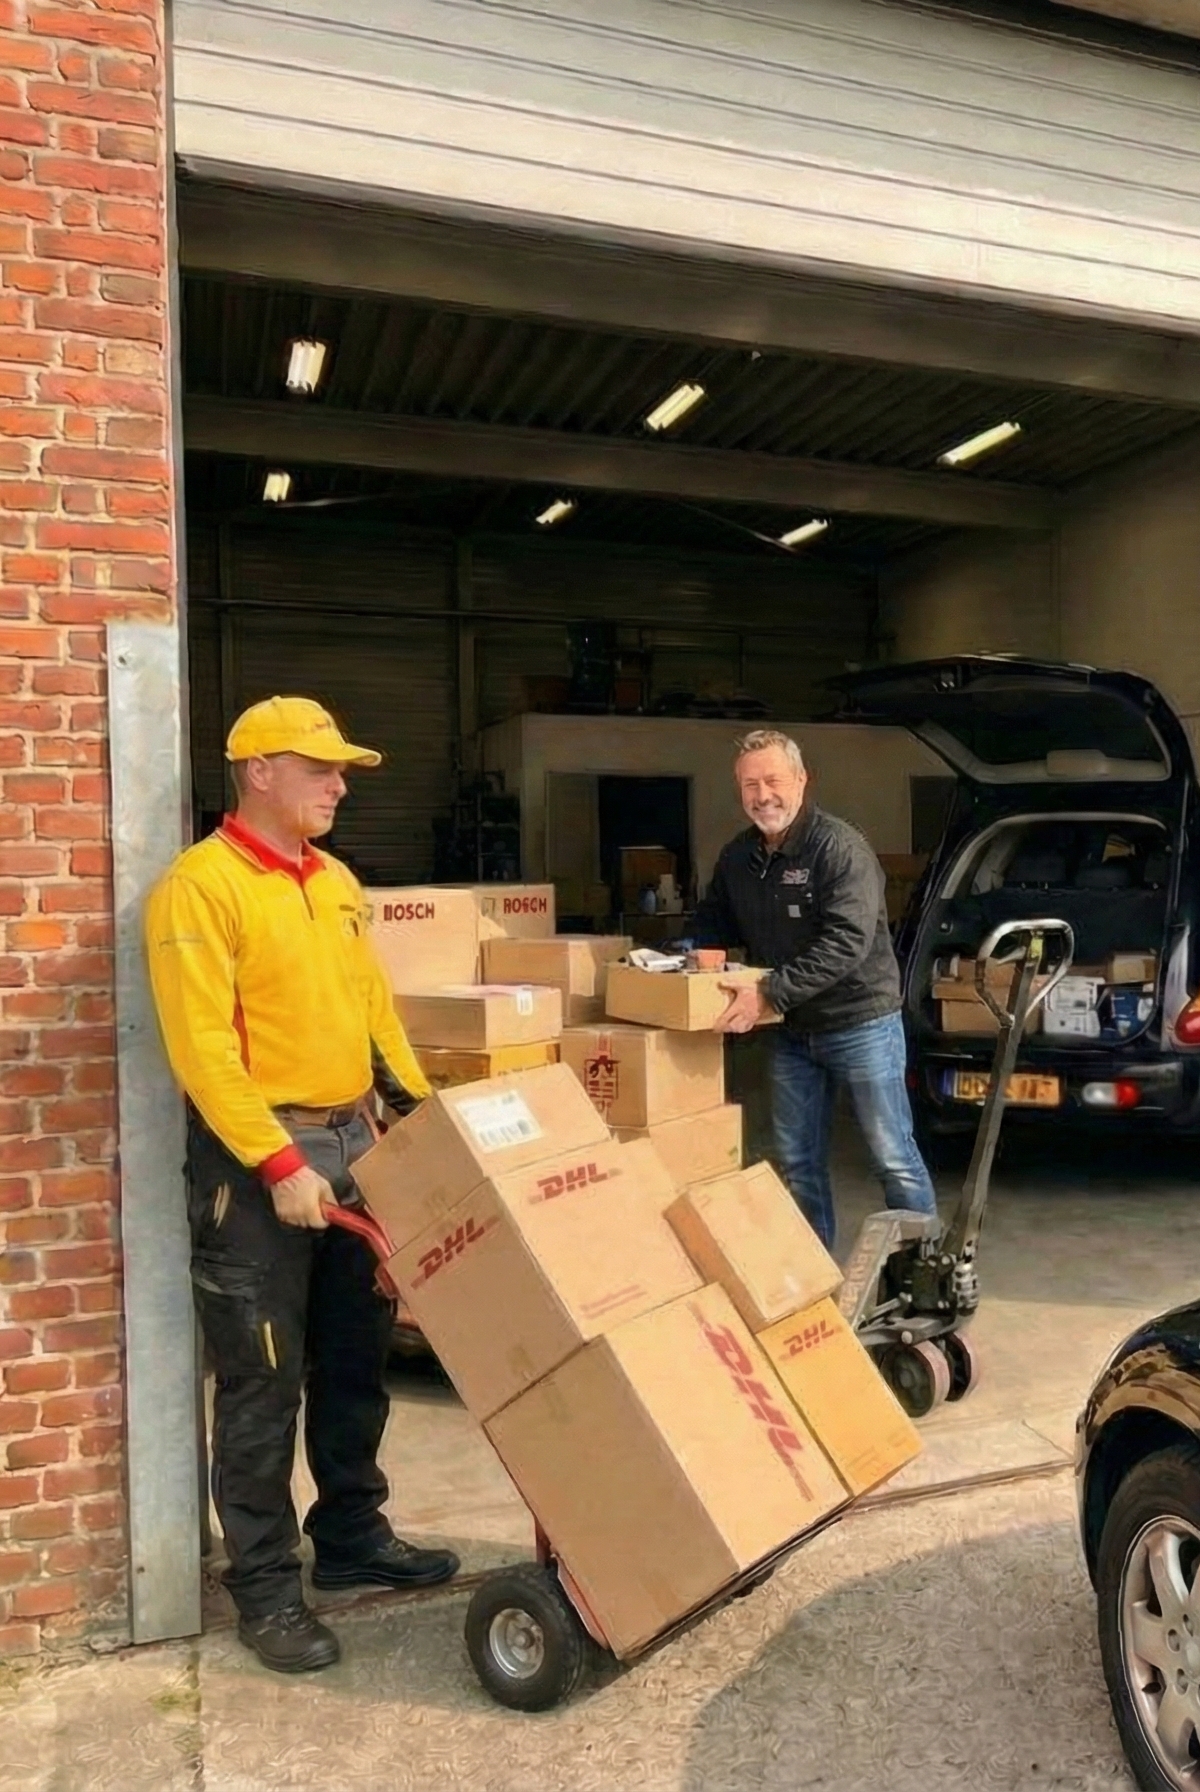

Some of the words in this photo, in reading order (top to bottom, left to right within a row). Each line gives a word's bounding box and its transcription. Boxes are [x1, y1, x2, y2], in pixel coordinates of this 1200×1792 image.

[537, 1163, 609, 1200] DHL
[416, 1219, 485, 1280] DHL
[784, 1320, 836, 1357] DHL
[705, 1323, 804, 1454] DHL
